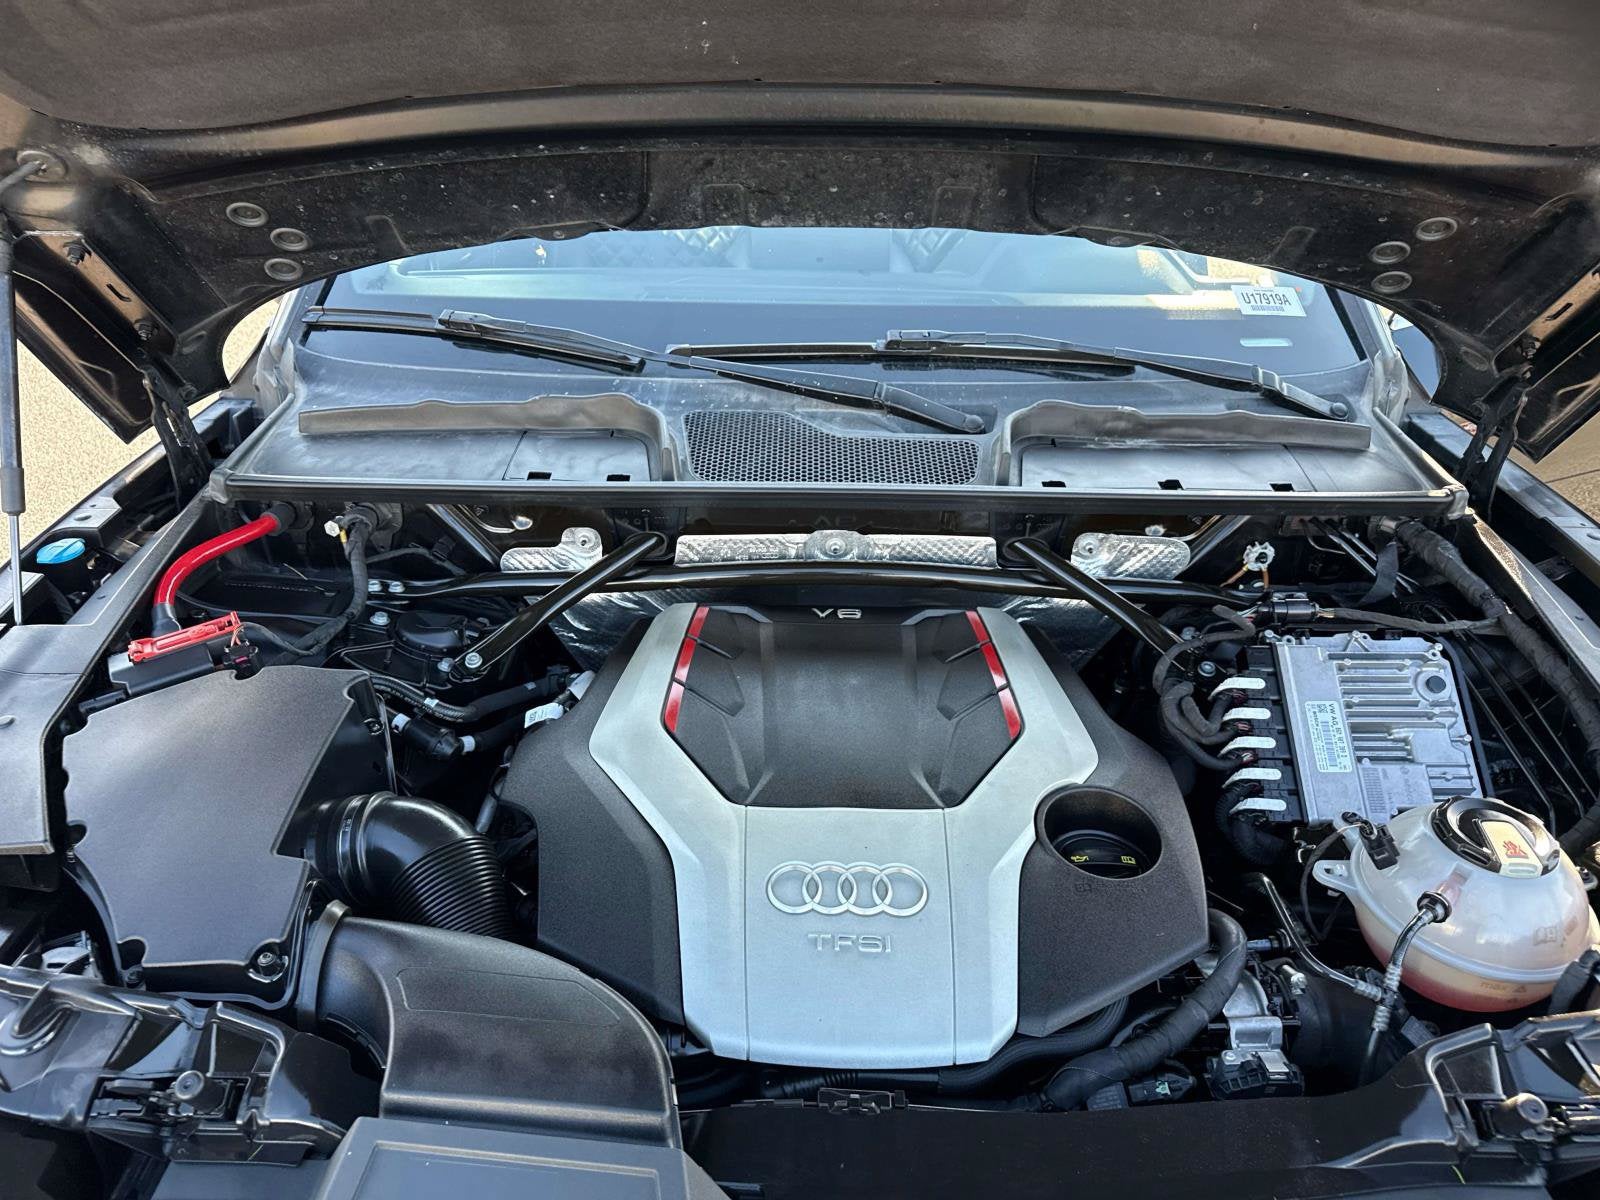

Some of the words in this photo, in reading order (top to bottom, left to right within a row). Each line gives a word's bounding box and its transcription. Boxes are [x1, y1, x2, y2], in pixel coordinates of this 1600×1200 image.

[1241, 292, 1292, 306] U17919A
[1328, 703, 1336, 715] VW
[807, 933, 892, 952] TFSI
